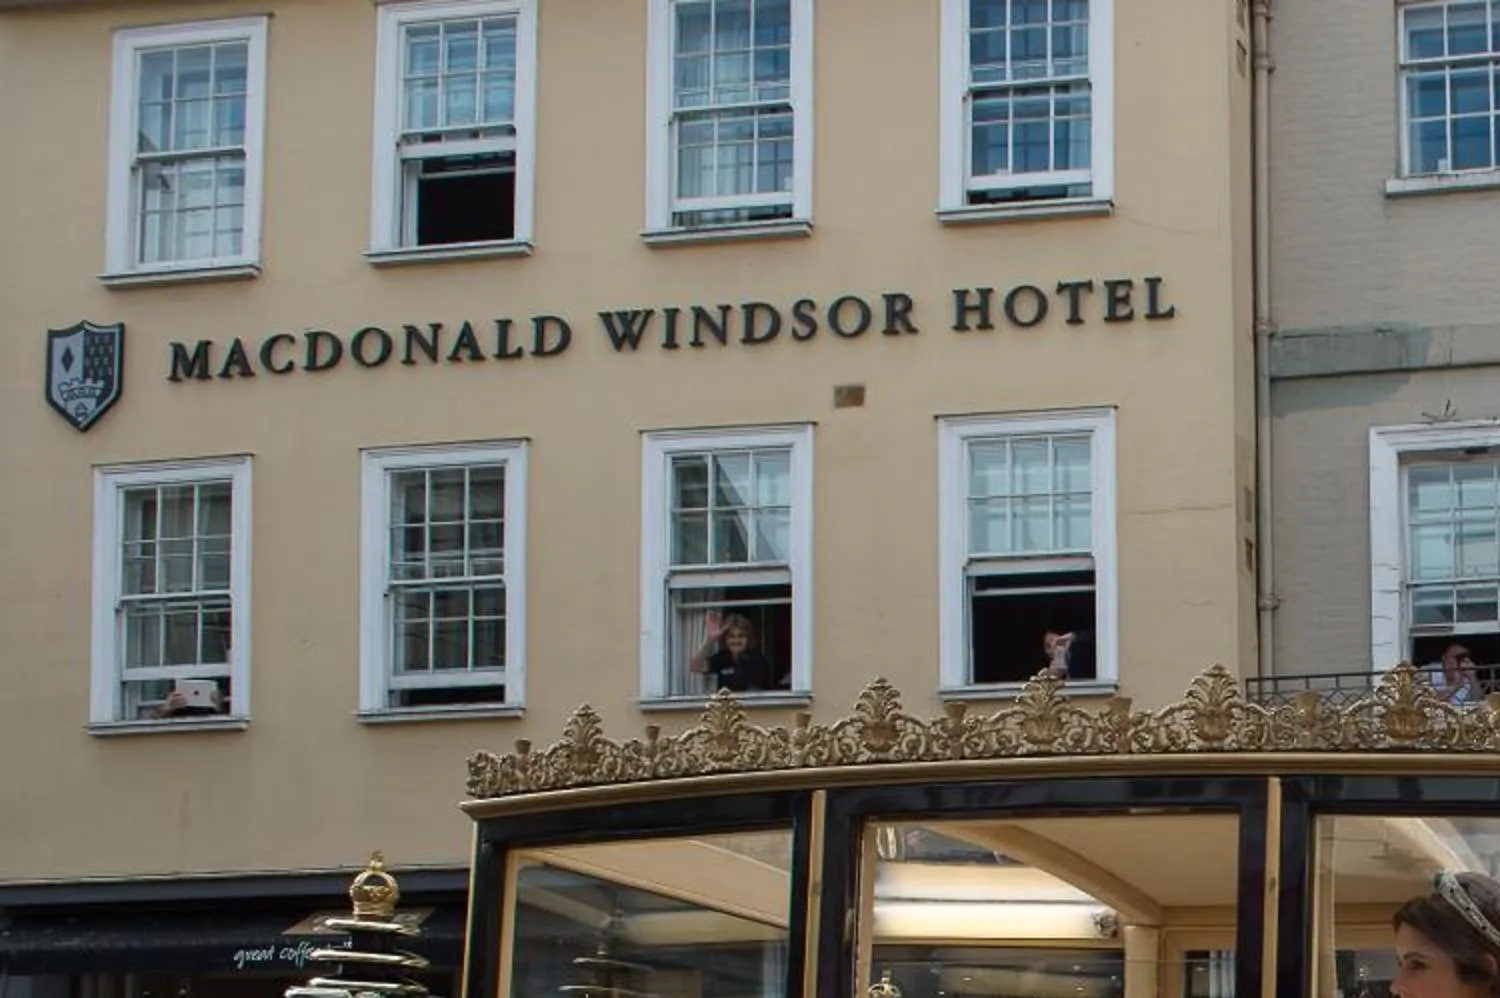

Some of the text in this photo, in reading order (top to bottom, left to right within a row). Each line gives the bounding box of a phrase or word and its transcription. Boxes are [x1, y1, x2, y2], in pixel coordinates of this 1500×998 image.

[166, 277, 1176, 382] MACDONALD WINDSOR HOTEL
[233, 944, 275, 970] great
